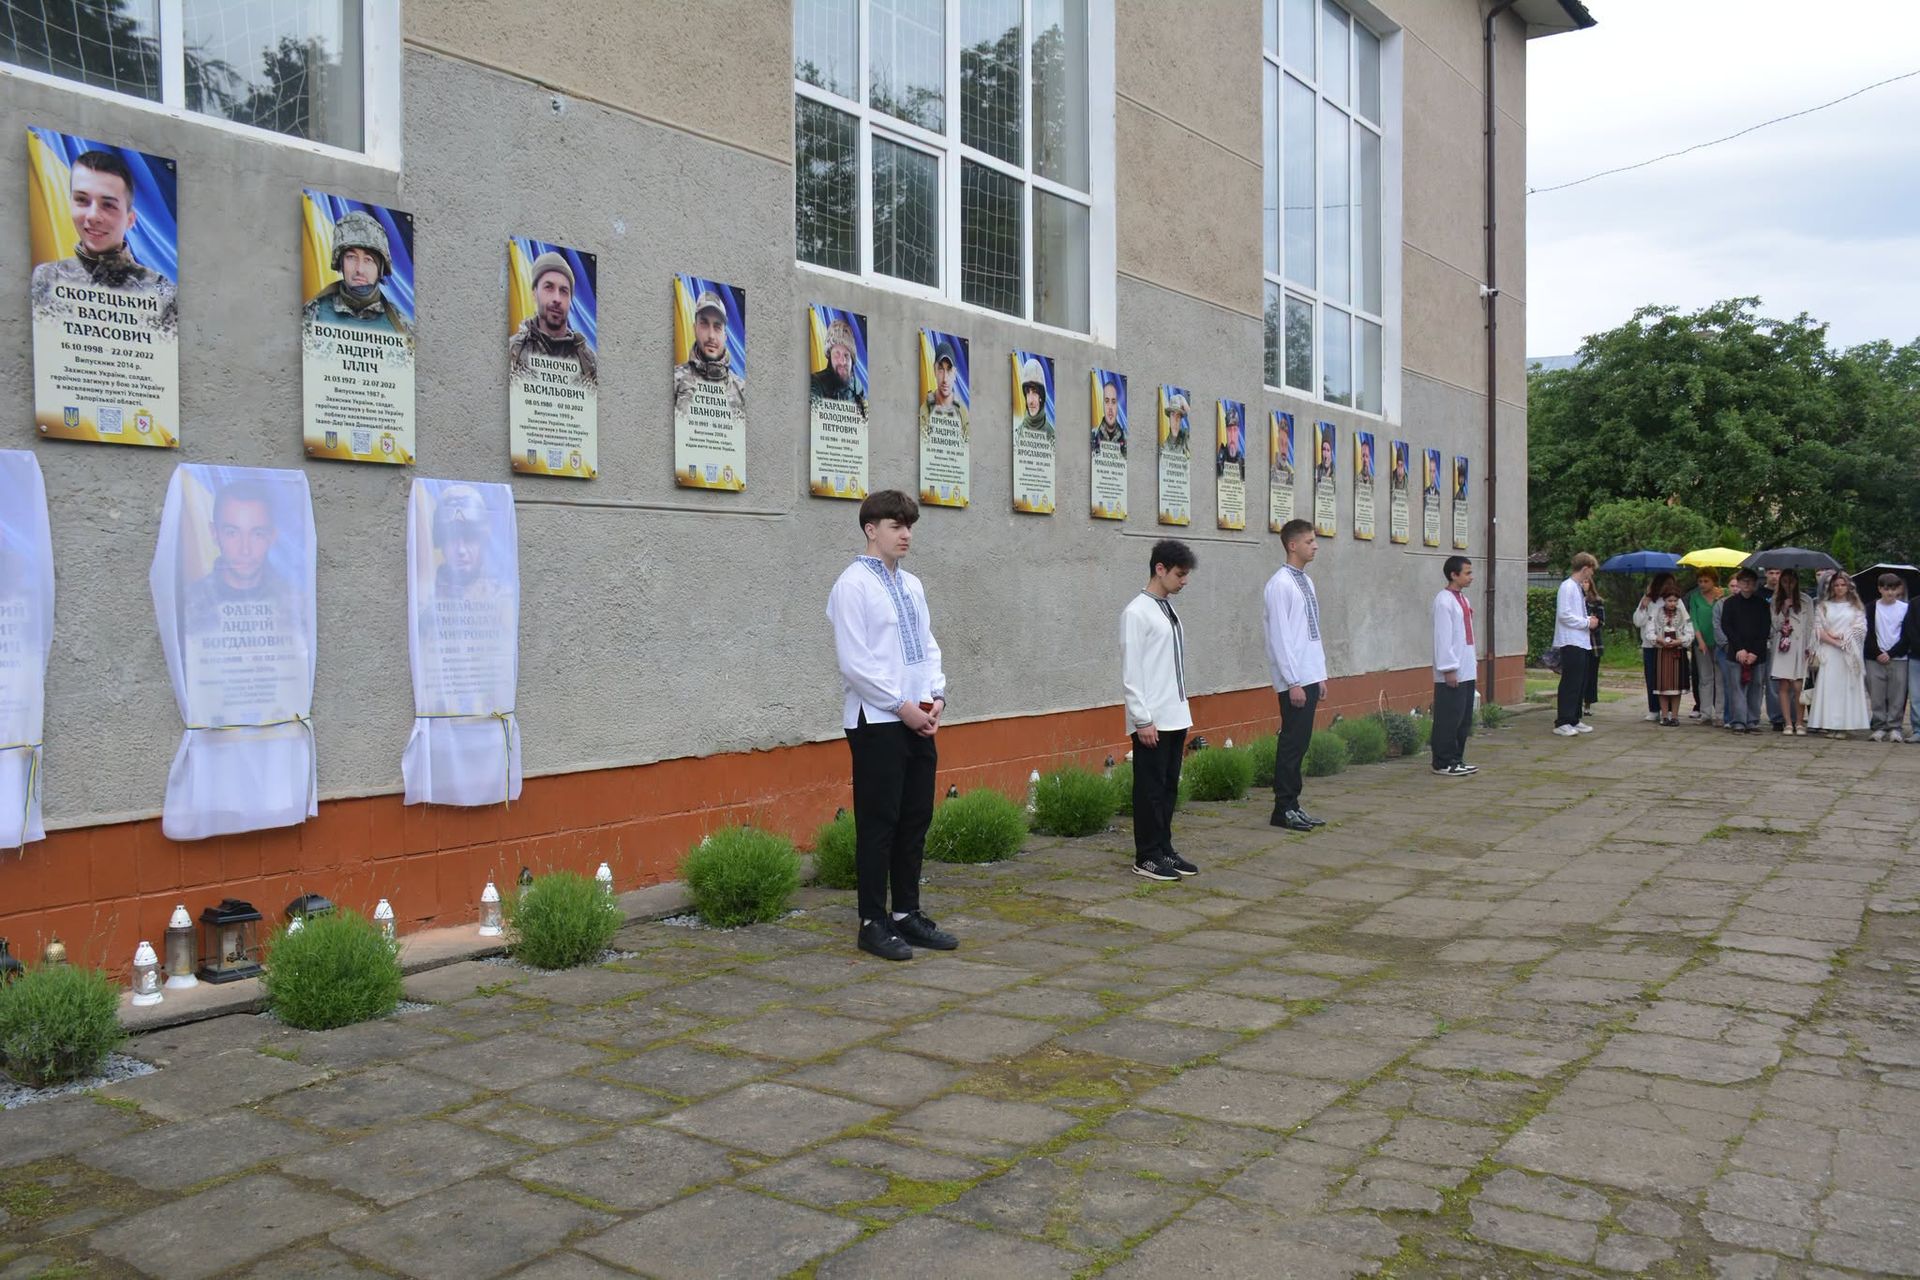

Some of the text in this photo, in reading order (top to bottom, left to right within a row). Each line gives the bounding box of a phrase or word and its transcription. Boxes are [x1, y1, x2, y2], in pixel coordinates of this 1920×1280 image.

[55, 286, 158, 311] СКОРЕЦЬКИЙ
[78, 306, 138, 325] ВАСИЛЬ
[63, 321, 152, 344] ТАРАСОВИЧ
[315, 325, 403, 348] ВОЛОШИНЮК
[336, 344, 384, 359] АНДРІЙ
[75, 356, 115, 367] Випускник
[117, 361, 134, 369] 2014
[342, 359, 378, 373] ІЛЛІЧ
[530, 357, 578, 373] ІВАНОЧКО
[64, 366, 97, 376] Захисник
[541, 371, 569, 385] ТАРАС
[50, 374, 81, 384] героїчно
[83, 378, 109, 387] загинув
[116, 380, 129, 388] бою
[140, 383, 165, 393] Україну
[697, 382, 724, 395] ТАЦЯК
[104, 388, 127, 397] пункті
[524, 383, 585, 400] ВАСИЛЬОВИЧ
[694, 394, 727, 407] СТЕПАН
[824, 401, 856, 413] КАРАЛАШ
[690, 406, 731, 420] ІВАНОВИЧ
[819, 411, 861, 425] ВОЛОДИМИР
[822, 422, 857, 436] ПЕТРОВИЧ
[931, 436, 960, 448] ІВАНОВИЧ
[222, 617, 274, 633] АНДРІЙ
